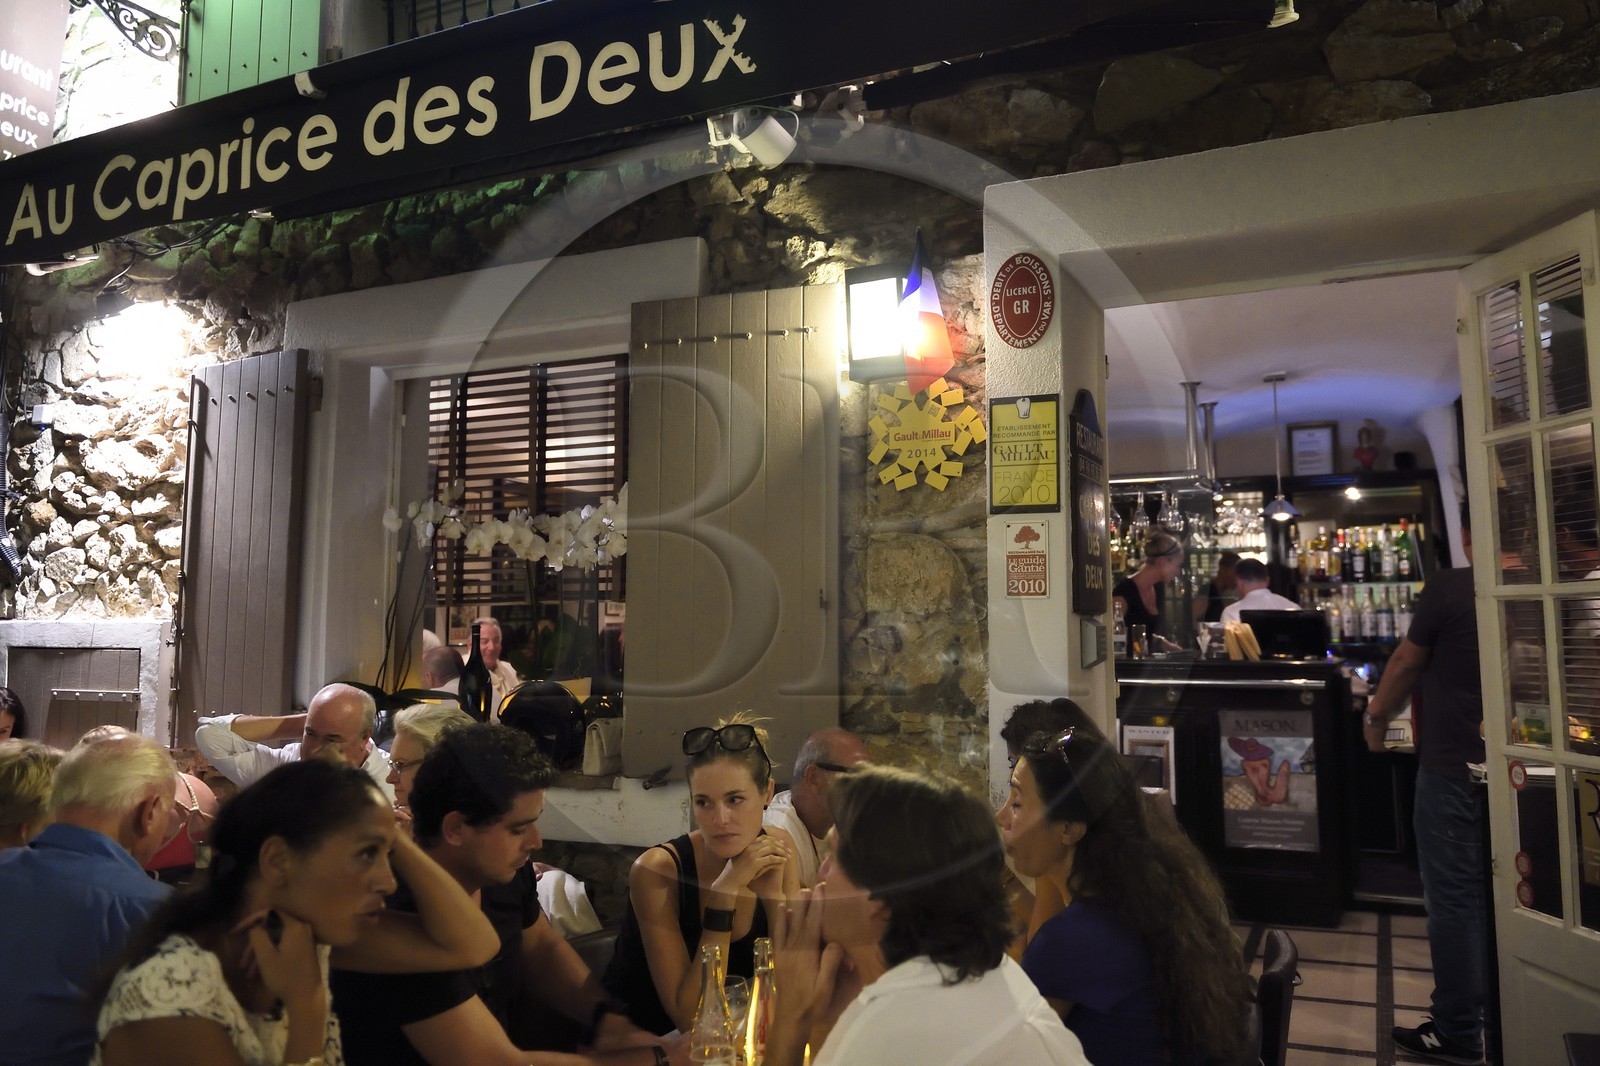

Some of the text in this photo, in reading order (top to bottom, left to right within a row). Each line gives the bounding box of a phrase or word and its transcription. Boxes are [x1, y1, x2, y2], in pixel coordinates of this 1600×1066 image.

[5, 13, 757, 245] Au Caprice des Deux
[992, 272, 1006, 300] DEBIT
[1015, 255, 1052, 295] BOISSONS
[1006, 286, 1037, 297] LICENCE
[1013, 300, 1030, 314] GR
[992, 306, 1041, 347] DEPARTEMENT
[1042, 301, 1052, 320] VAR
[907, 448, 936, 459] 2014
[993, 443, 1043, 455] GAULT
[1000, 450, 1055, 462] MILLAU
[994, 469, 1055, 483] FRANCE
[999, 484, 1051, 504] 2010
[1018, 555, 1045, 566] guide
[1085, 564, 1104, 591] DEUX
[1008, 579, 1045, 594] 2010
[1234, 719, 1297, 732] MASON
